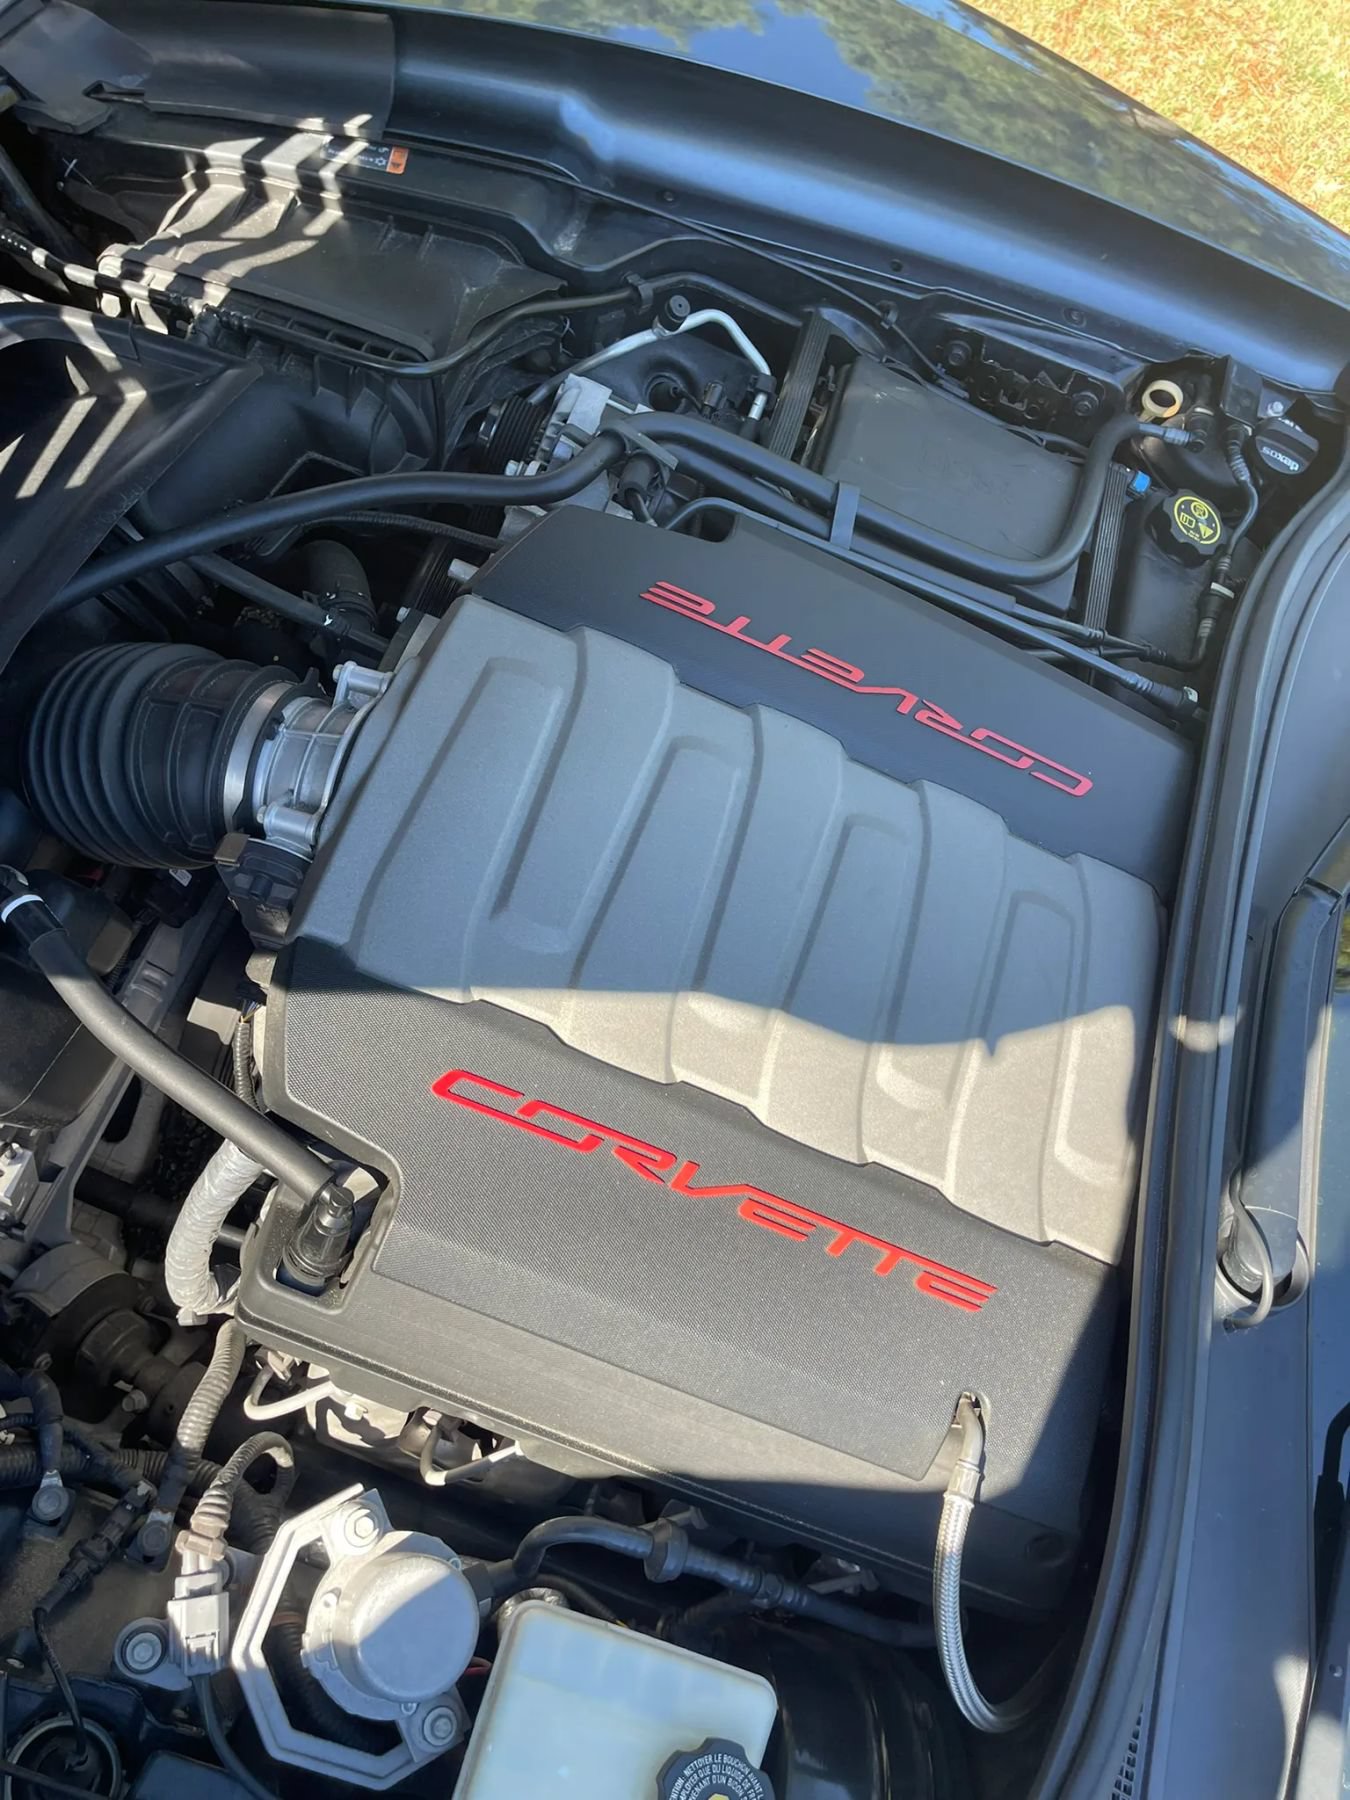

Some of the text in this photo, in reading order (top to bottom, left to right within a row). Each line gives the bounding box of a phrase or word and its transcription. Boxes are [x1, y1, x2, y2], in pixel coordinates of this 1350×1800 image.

[1262, 446, 1300, 471] dexos
[640, 581, 1092, 797] CORVETTE
[432, 1069, 997, 1312] CORVETTE
[683, 1754, 713, 1777] NETTOYER
[713, 1753, 722, 1763] LE
[723, 1754, 750, 1775] BOUCHON
[748, 1772, 763, 1793] AVANT
[697, 1765, 711, 1778] QUE
[721, 1764, 745, 1783] LIQUIDE
